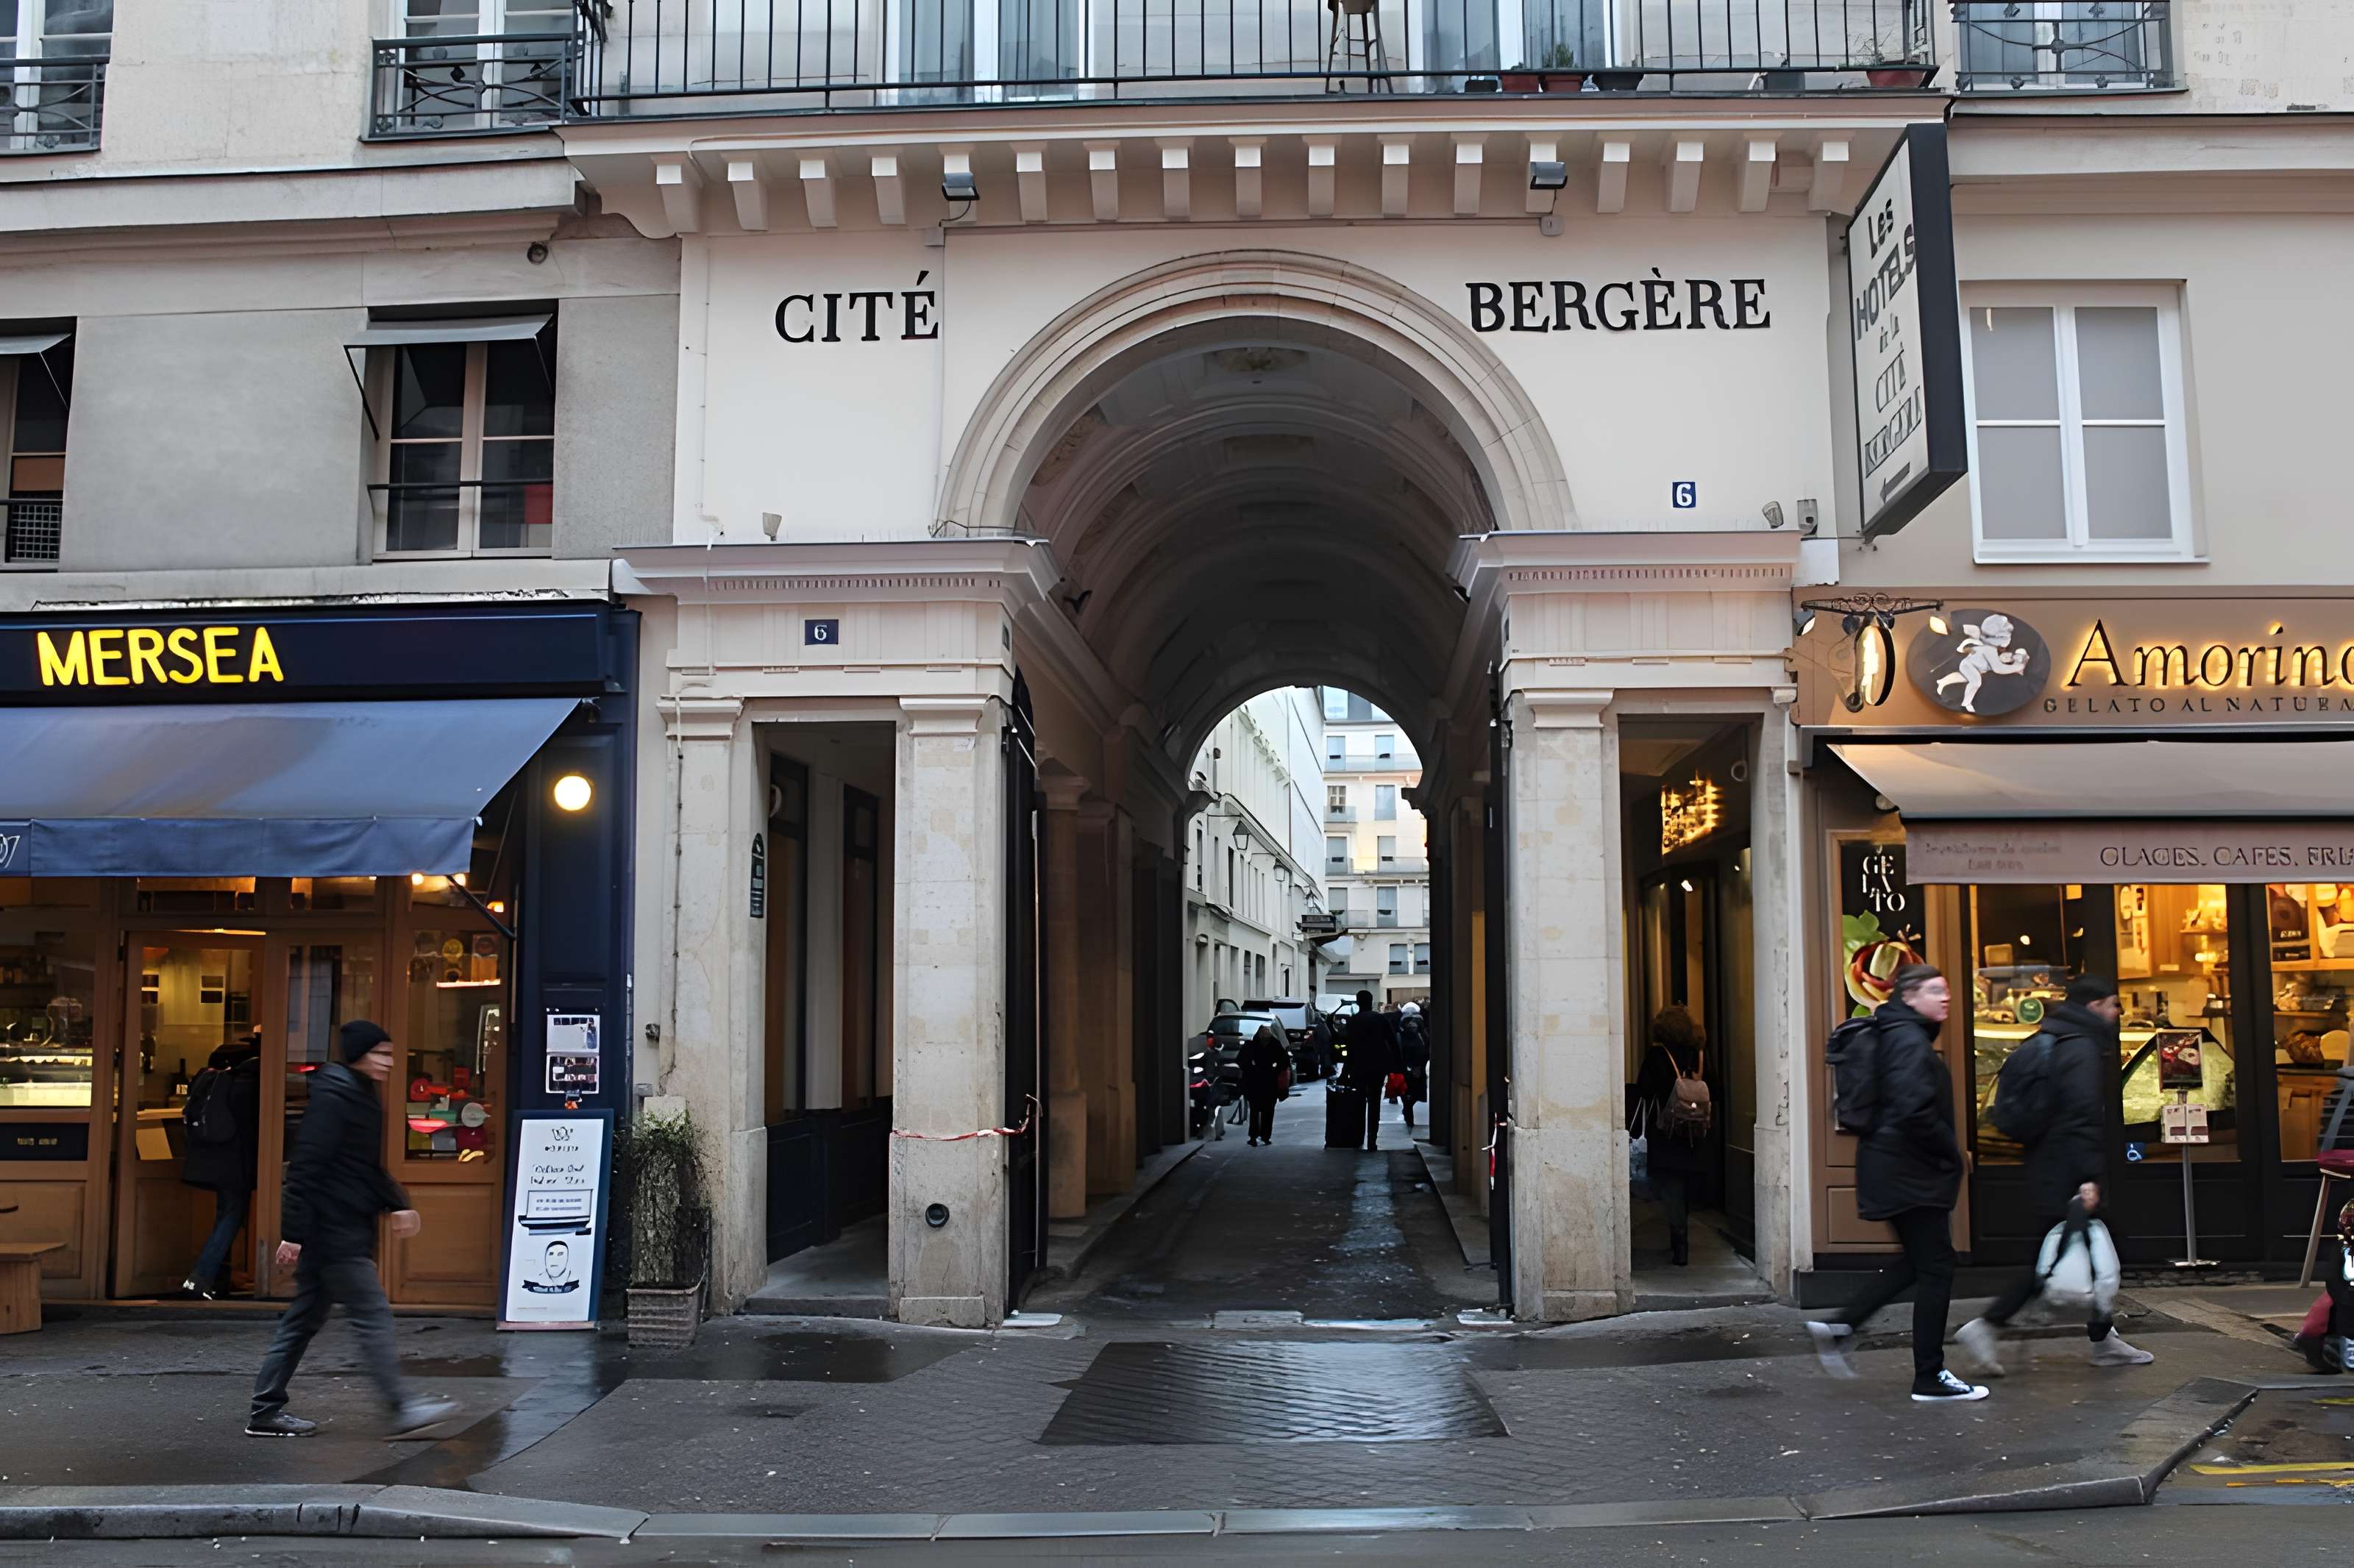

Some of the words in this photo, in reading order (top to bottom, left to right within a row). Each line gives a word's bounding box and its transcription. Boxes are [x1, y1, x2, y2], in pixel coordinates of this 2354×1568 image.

[775, 270, 939, 343] CITÉ
[1465, 266, 1771, 333] BERGÈRE
[1676, 483, 1692, 507] 6
[814, 624, 828, 641] 6
[37, 627, 285, 686] MERSEA
[2044, 697, 2166, 713] GELATO
[2181, 697, 2213, 713] AL
